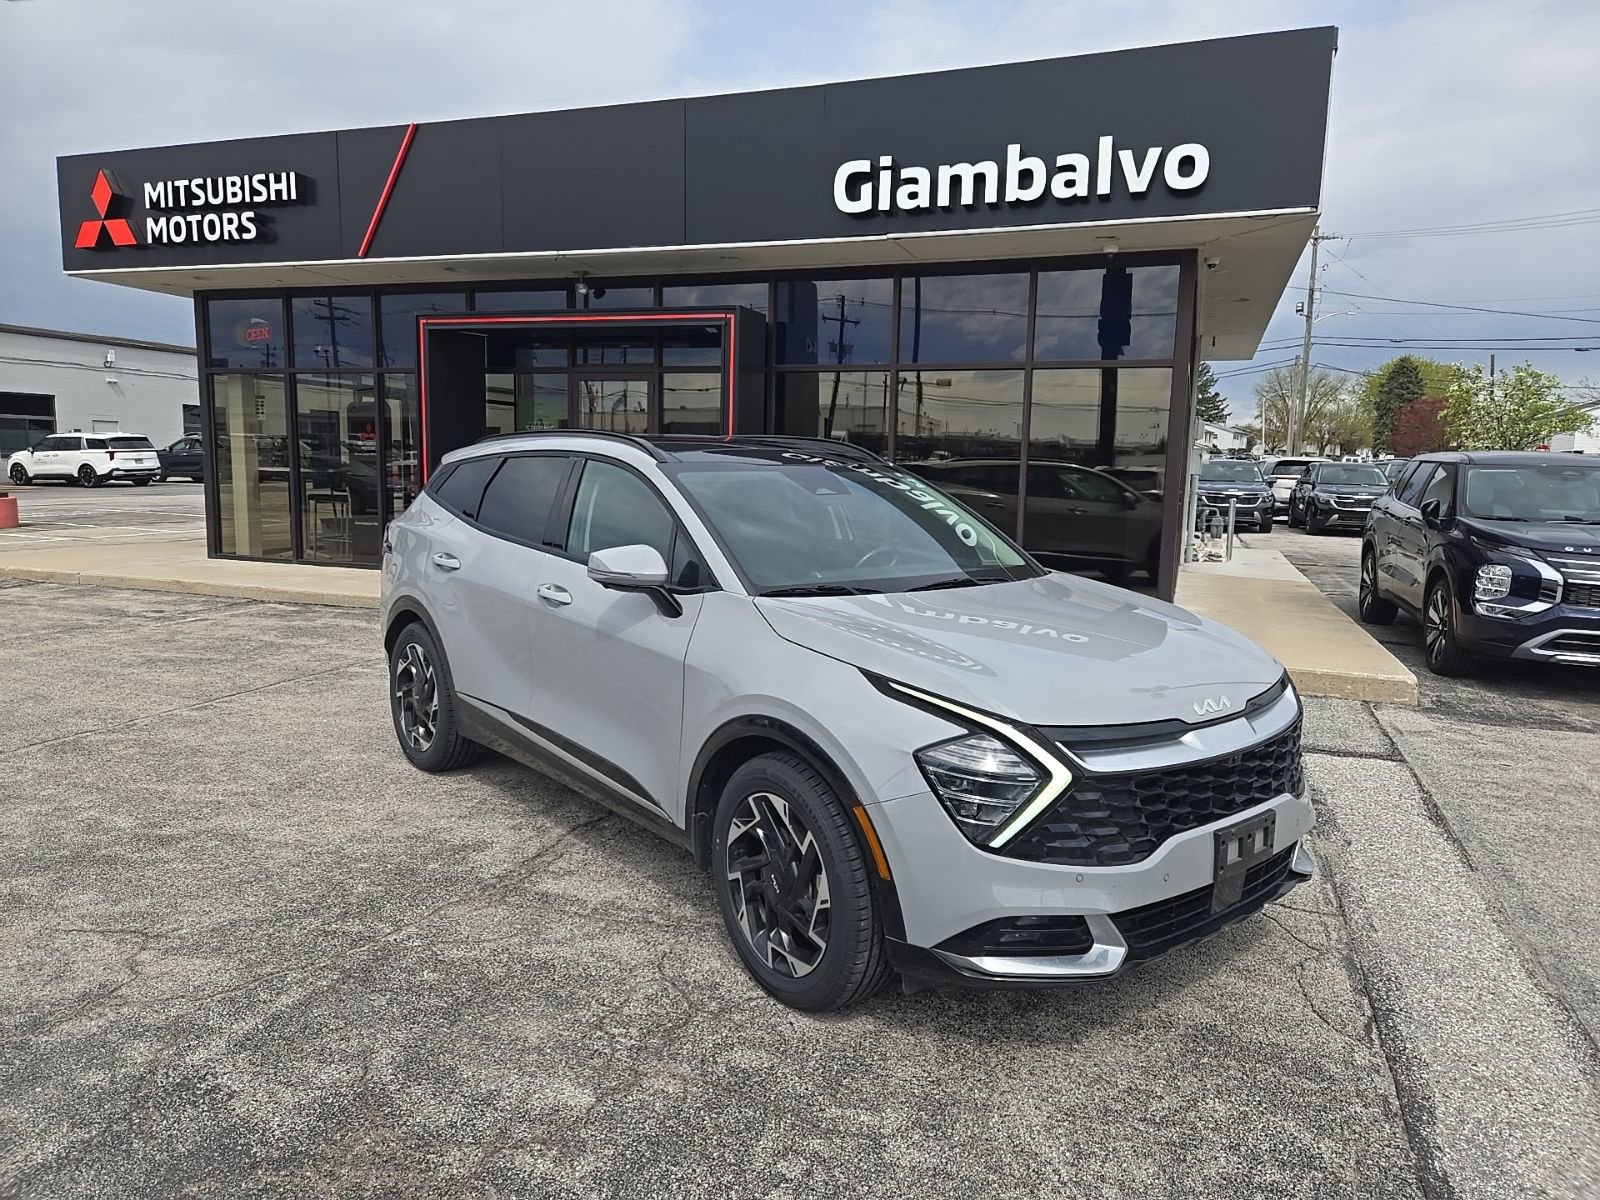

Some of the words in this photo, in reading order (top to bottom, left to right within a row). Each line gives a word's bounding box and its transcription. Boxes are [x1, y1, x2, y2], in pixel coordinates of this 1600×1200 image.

[143, 171, 298, 209] MITSUBISHI
[833, 135, 1210, 213] Giambalvo
[146, 211, 257, 244] MOTORS
